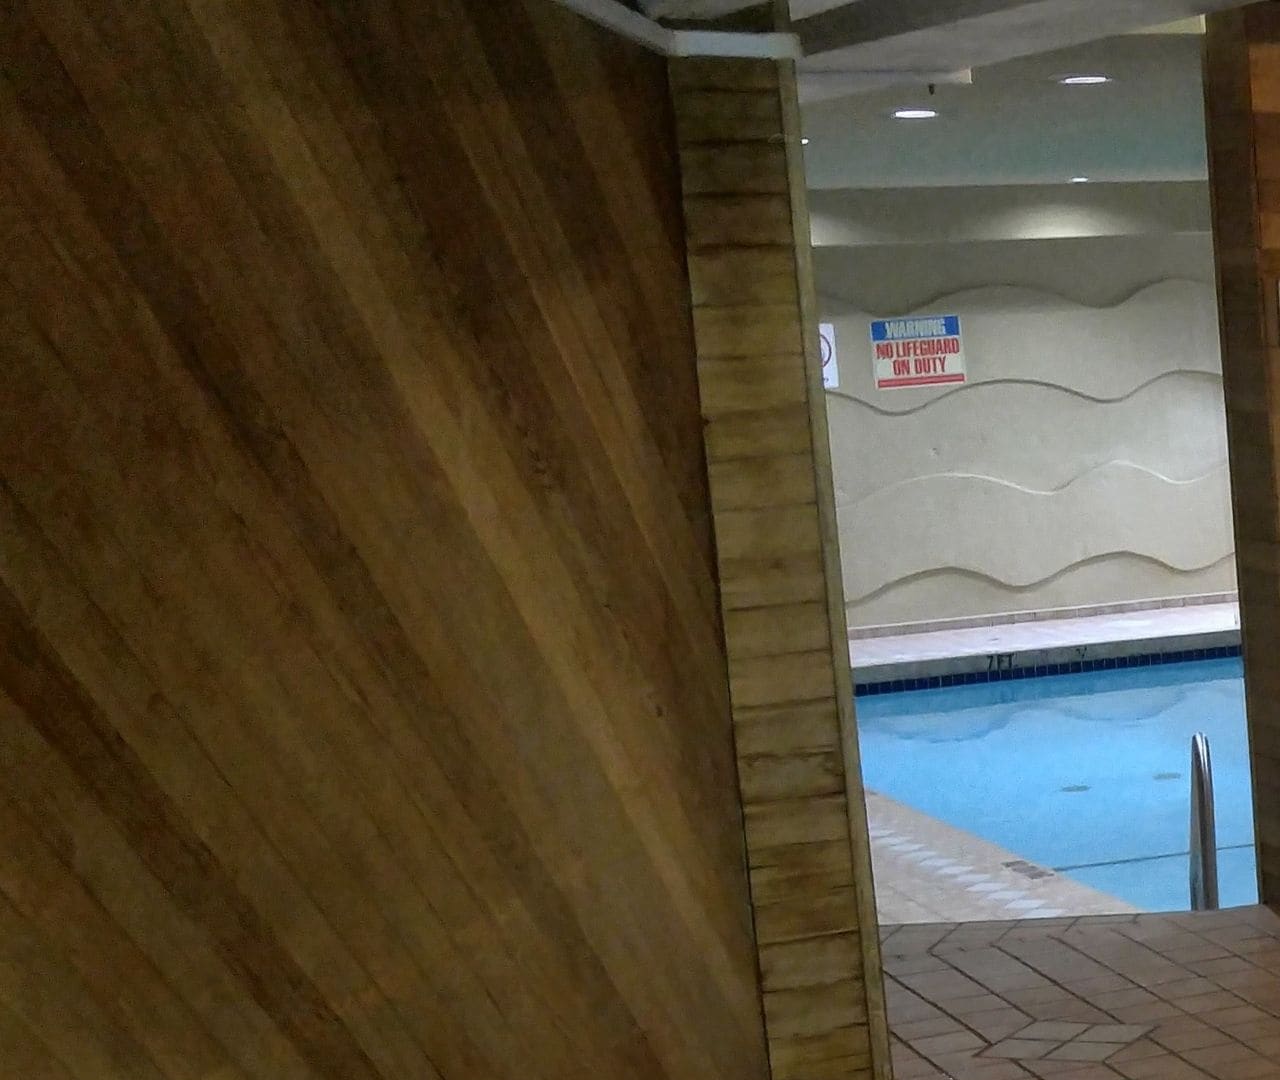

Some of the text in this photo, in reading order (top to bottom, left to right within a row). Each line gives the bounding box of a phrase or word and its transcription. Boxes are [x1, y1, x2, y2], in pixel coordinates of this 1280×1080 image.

[885, 319, 946, 338] WARNING
[876, 338, 960, 359] NO LIFEGUARD
[893, 355, 947, 375] ON DUTY
